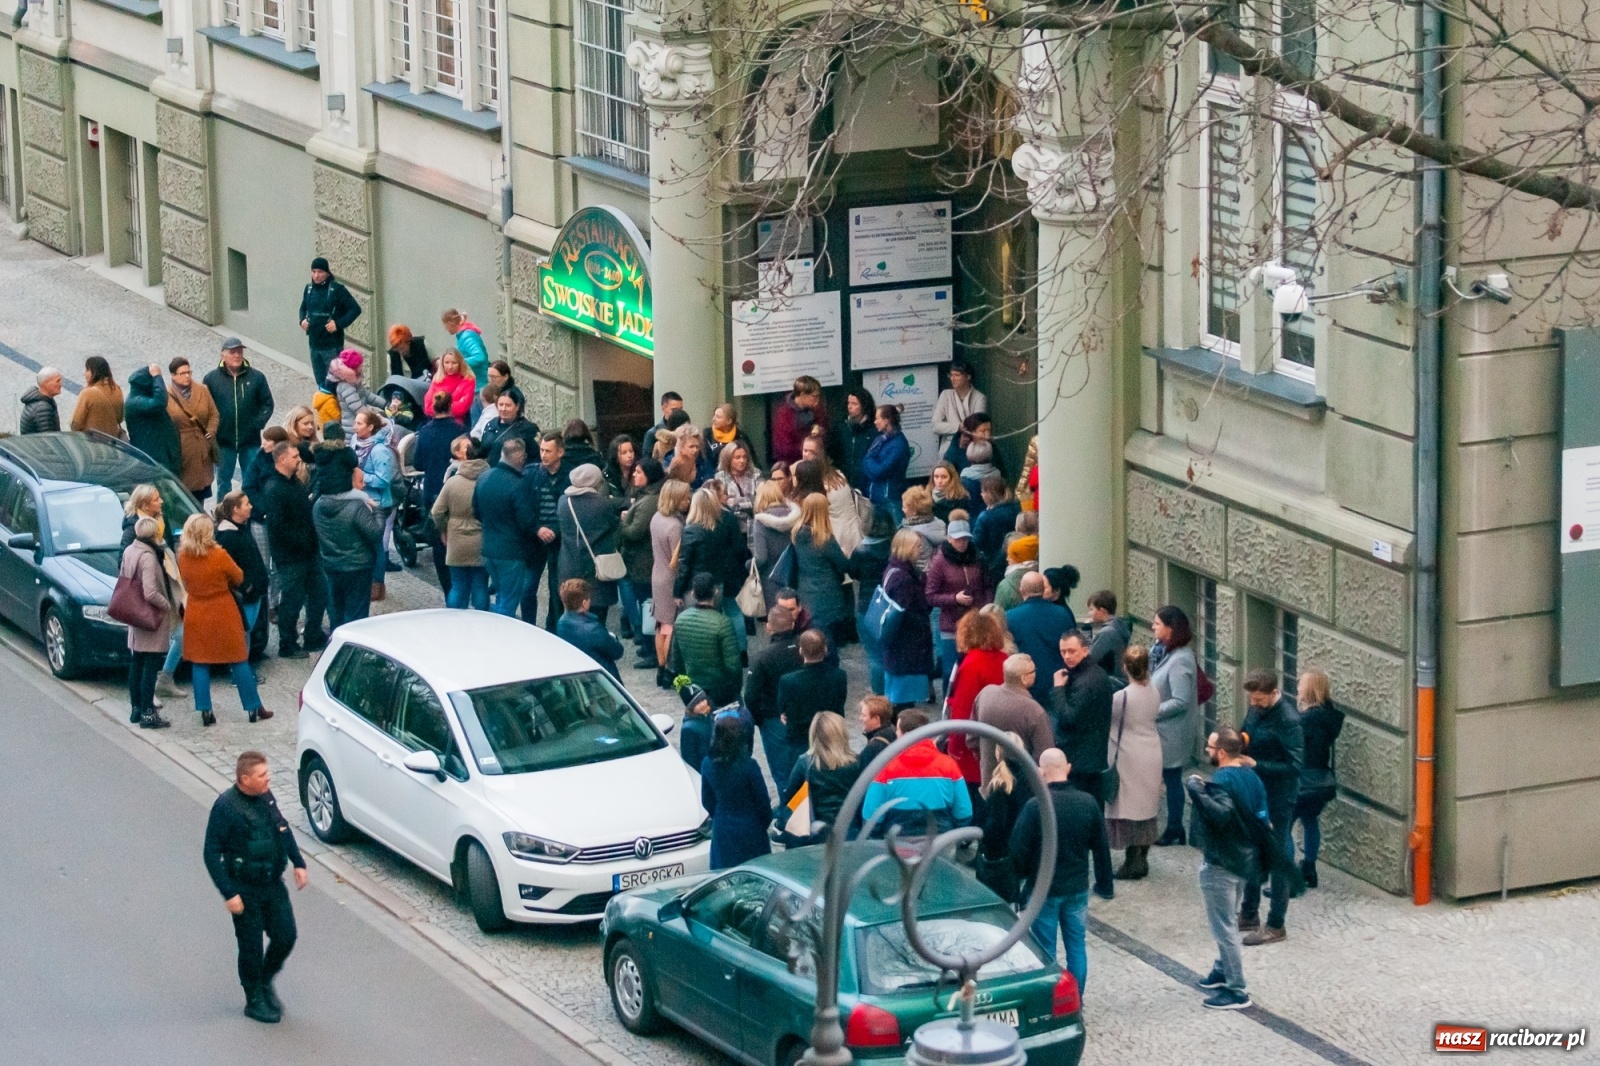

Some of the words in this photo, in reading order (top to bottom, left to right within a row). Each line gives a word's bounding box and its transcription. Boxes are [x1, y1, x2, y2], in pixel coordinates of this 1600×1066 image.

[543, 275, 614, 326] SWOJSKIE
[615, 300, 654, 342] JADŁ
[622, 871, 648, 888] SRC
